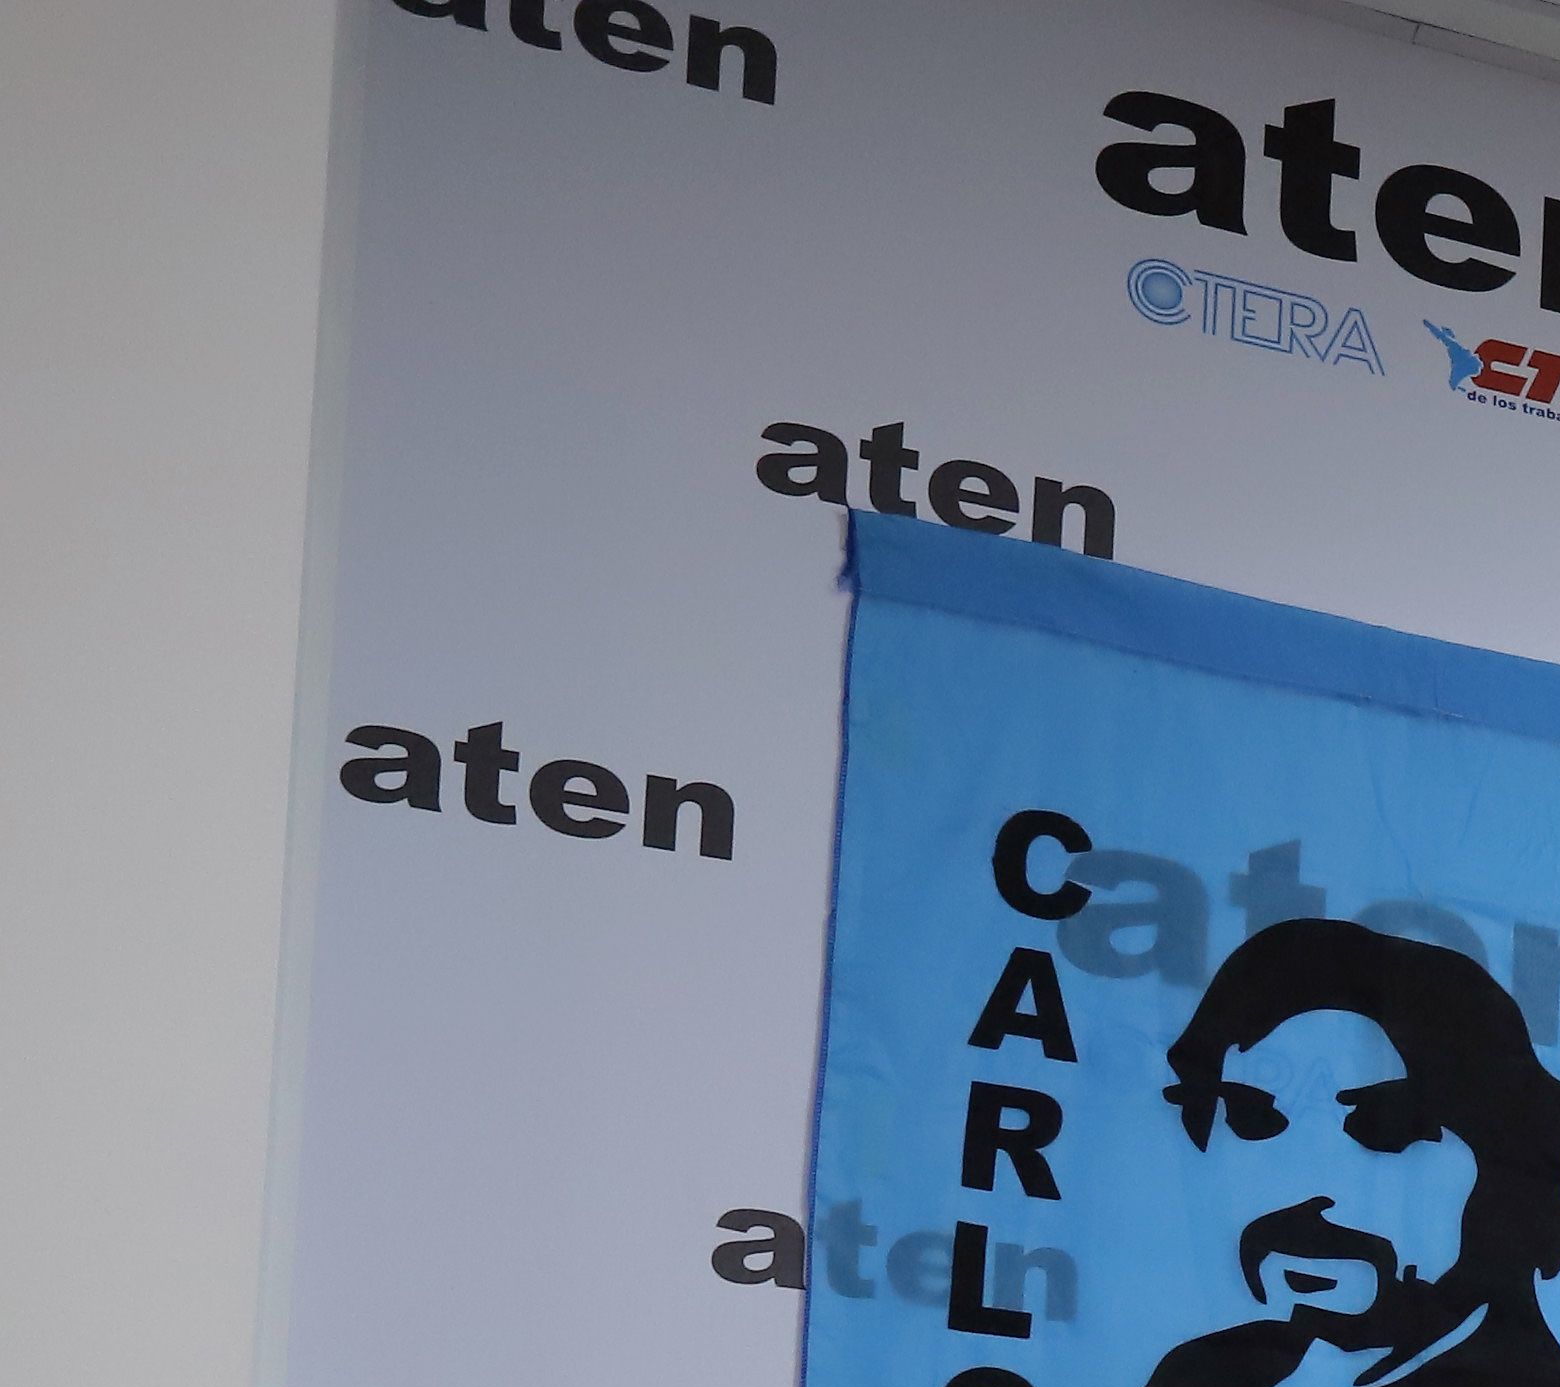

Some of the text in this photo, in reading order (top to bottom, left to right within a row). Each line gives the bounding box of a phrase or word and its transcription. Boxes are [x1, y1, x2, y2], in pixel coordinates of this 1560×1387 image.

[1466, 389, 1487, 404] de
[1492, 394, 1517, 411] los
[756, 421, 1116, 560] aten
[339, 721, 736, 861] aten
[711, 1200, 1080, 1322] aten
